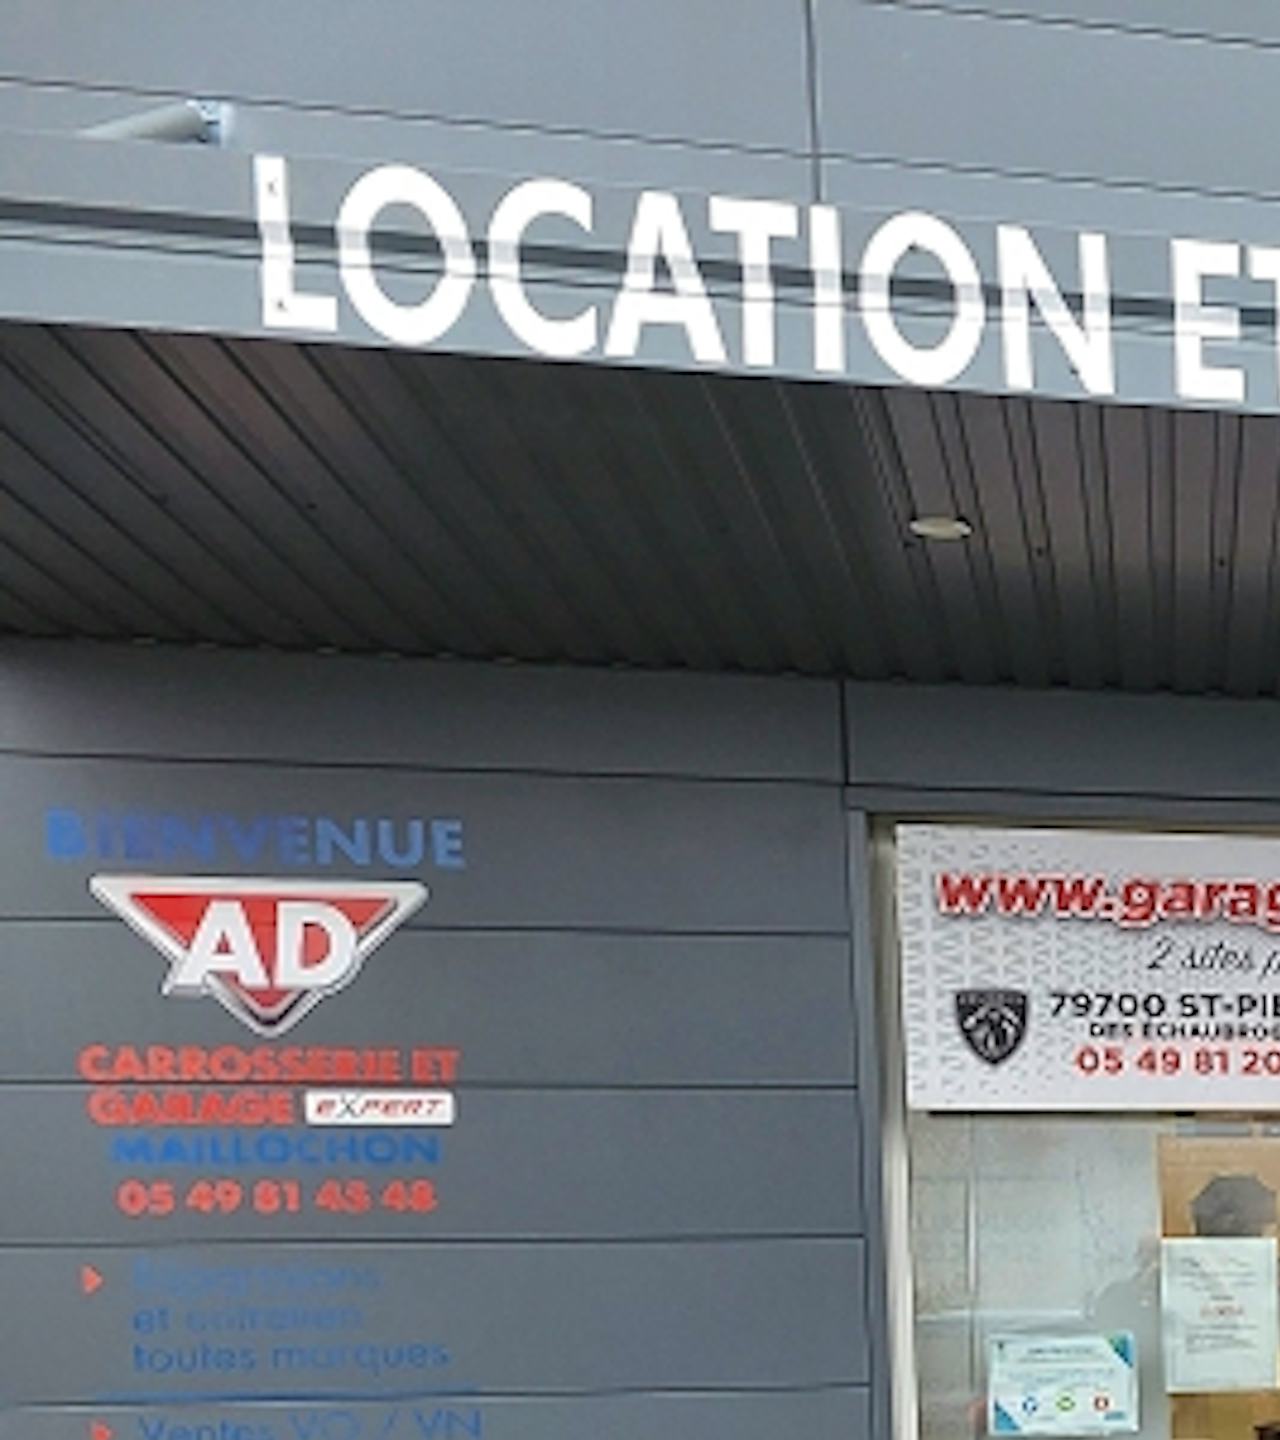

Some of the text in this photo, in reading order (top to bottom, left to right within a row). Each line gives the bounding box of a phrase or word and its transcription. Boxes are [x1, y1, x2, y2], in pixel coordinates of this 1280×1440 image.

[252, 153, 1114, 396] LOCATION
[44, 808, 466, 867] BIENVENUE
[168, 899, 360, 990] AD
[1146, 936, 1171, 971] 2
[1049, 993, 1166, 1019] 79700
[76, 1044, 460, 1082] CARROSSERIE ET
[1076, 1047, 1123, 1075] 05
[1137, 1047, 1181, 1075] 49
[1195, 1049, 1230, 1075] 81
[86, 1086, 295, 1126] GARAGE
[111, 1132, 442, 1165] MAILLOCHON
[116, 1179, 175, 1216] 05
[186, 1179, 241, 1214] 49
[253, 1179, 301, 1213] 81
[383, 1178, 438, 1213] 48
[132, 1342, 257, 1374] toutes
[412, 1409, 484, 1440] VN
